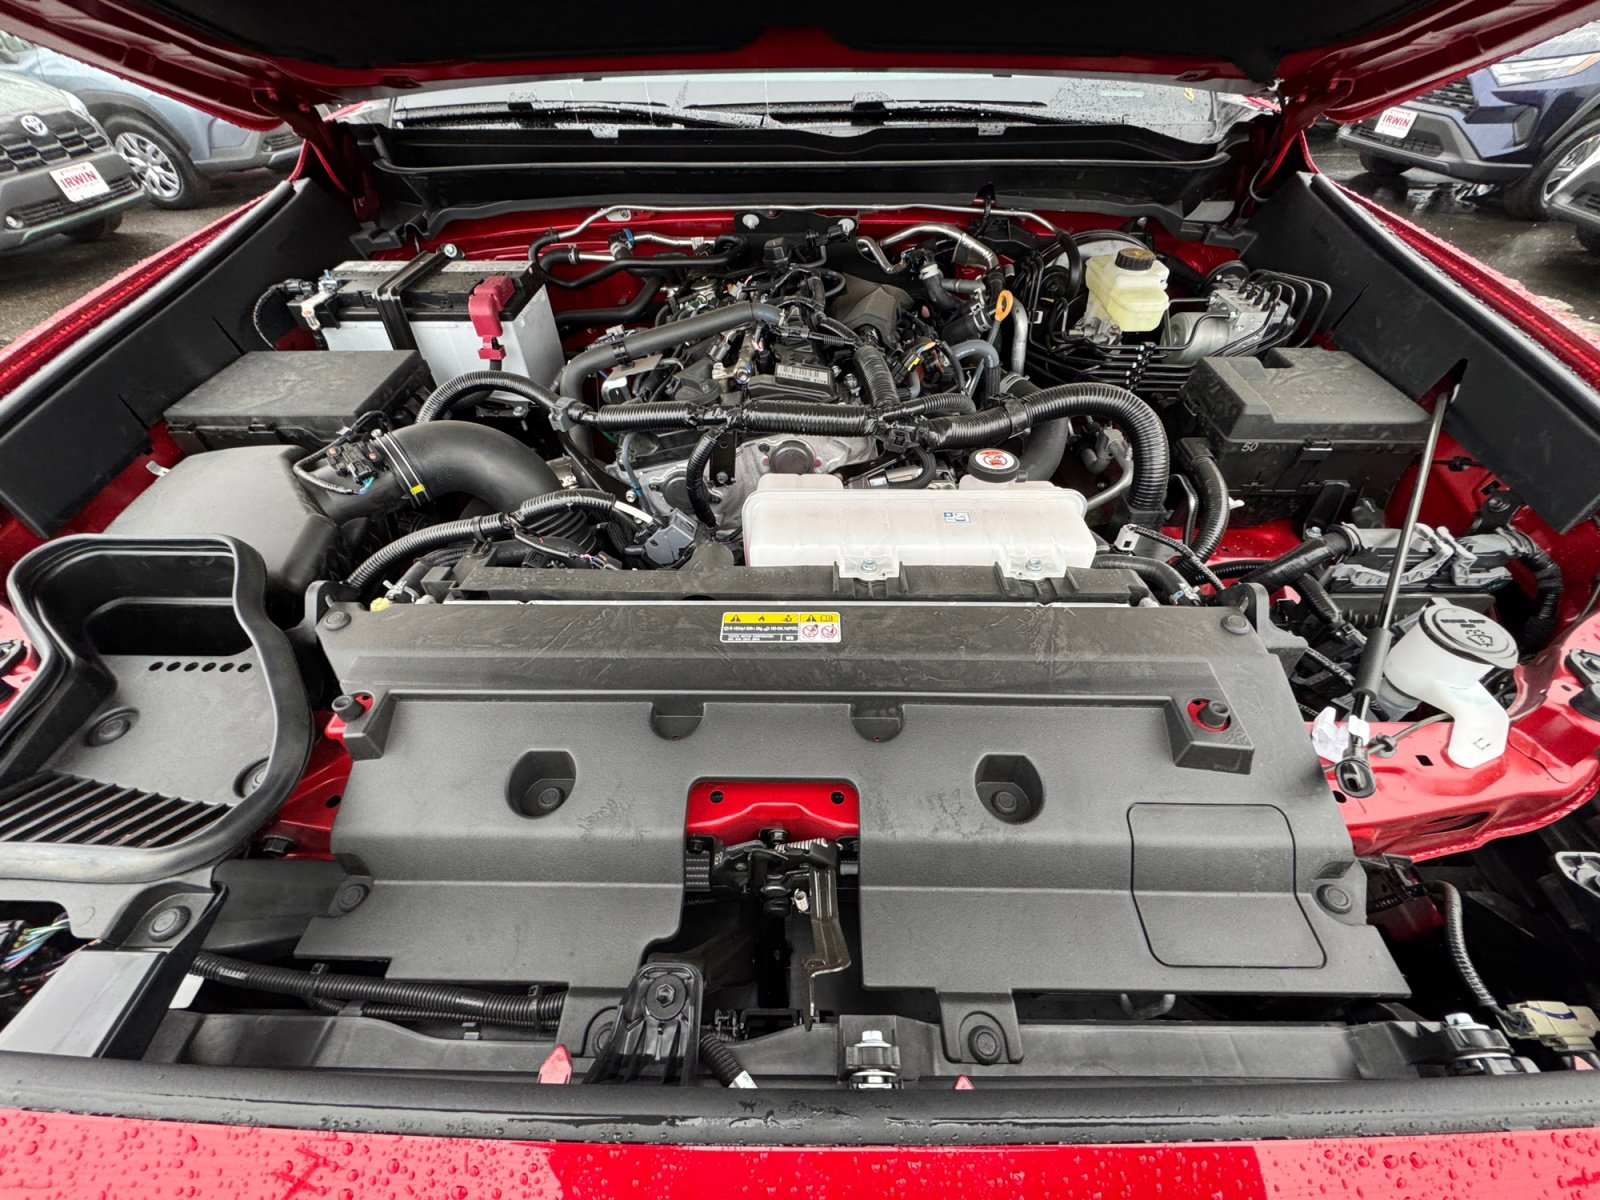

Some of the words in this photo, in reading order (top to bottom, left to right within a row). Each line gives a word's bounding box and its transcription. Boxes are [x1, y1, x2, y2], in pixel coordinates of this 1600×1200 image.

[1382, 113, 1411, 128] IRWIN
[60, 170, 98, 189] IRWIN
[1241, 441, 1259, 452] 50
